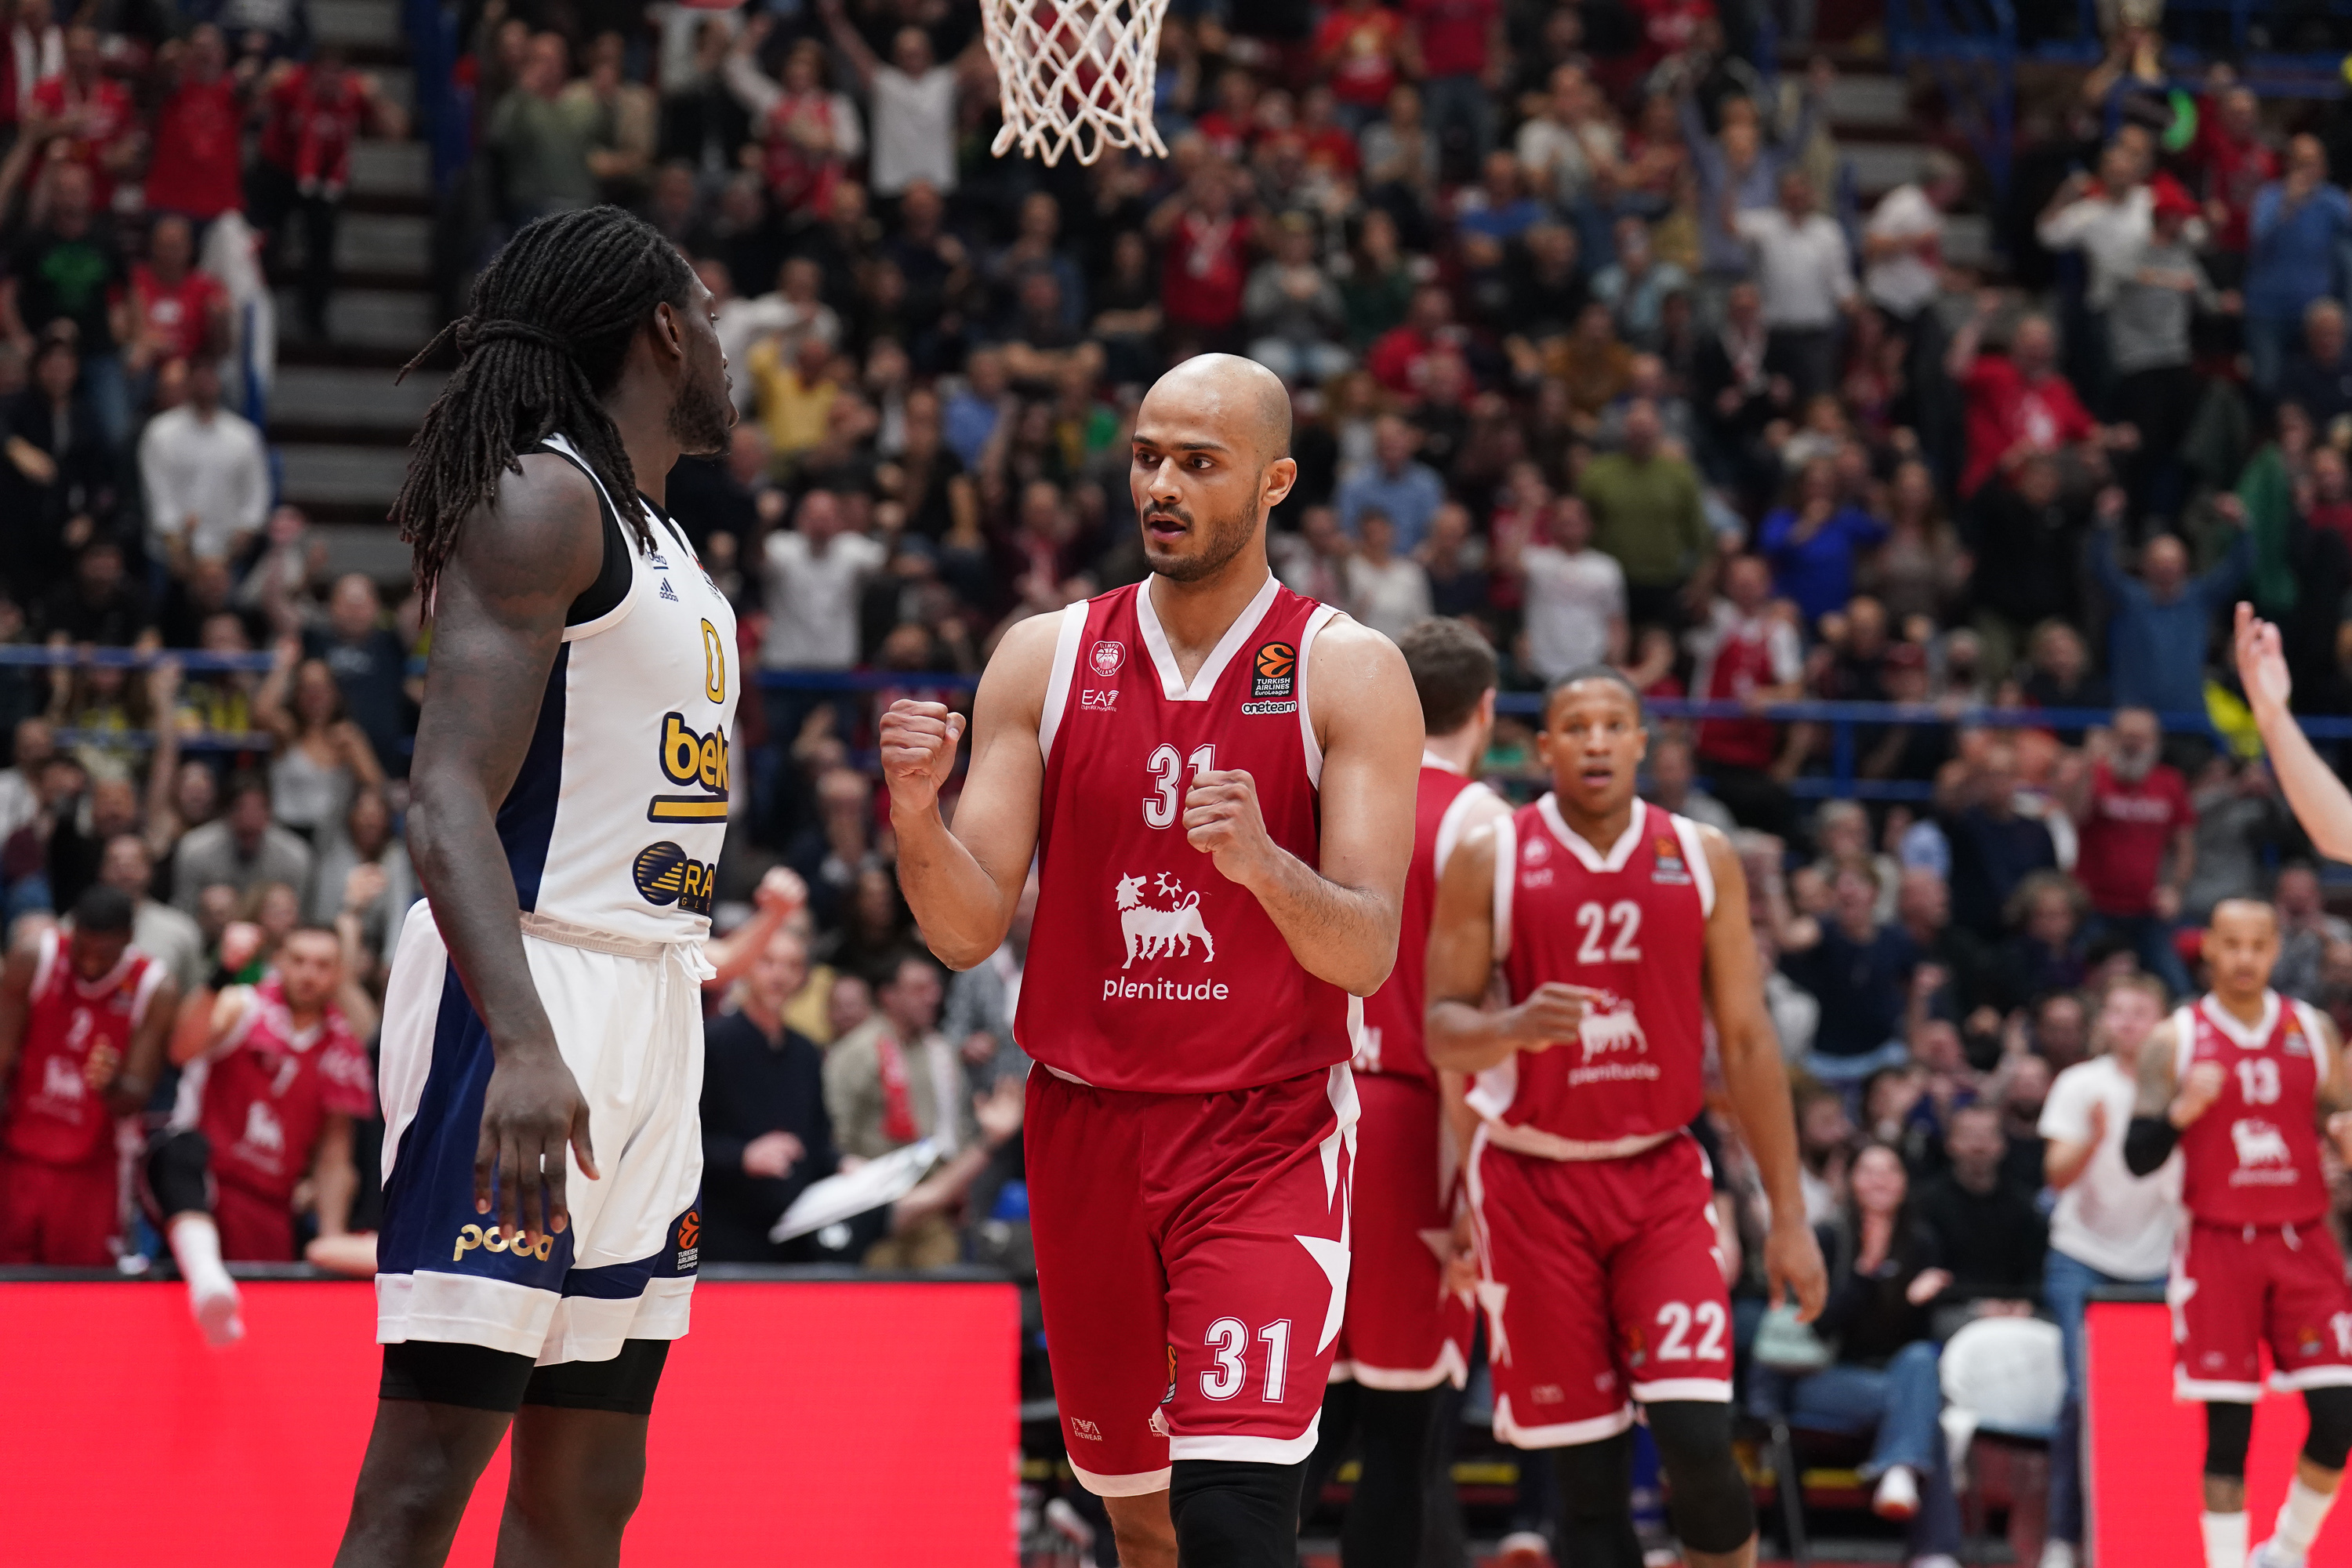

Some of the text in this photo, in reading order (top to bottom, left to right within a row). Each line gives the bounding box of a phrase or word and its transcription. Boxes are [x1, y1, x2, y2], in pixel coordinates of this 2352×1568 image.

[702, 618, 725, 704] 0
[1095, 666, 1116, 675] MILANO
[1243, 701, 1297, 714] oneteam
[662, 714, 729, 792] bek
[1576, 900, 1643, 964] 22
[1102, 976, 1229, 1001] plenitude
[2234, 1057, 2281, 1105] 13
[677, 1247, 699, 1258] TURKISH
[677, 1254, 698, 1265] AIRLINES
[1656, 1300, 1726, 1362] 22
[2329, 1310, 2352, 1356] 1
[1200, 1316, 1292, 1403] 31
[1074, 1430, 1103, 1442] EYEWEAR
